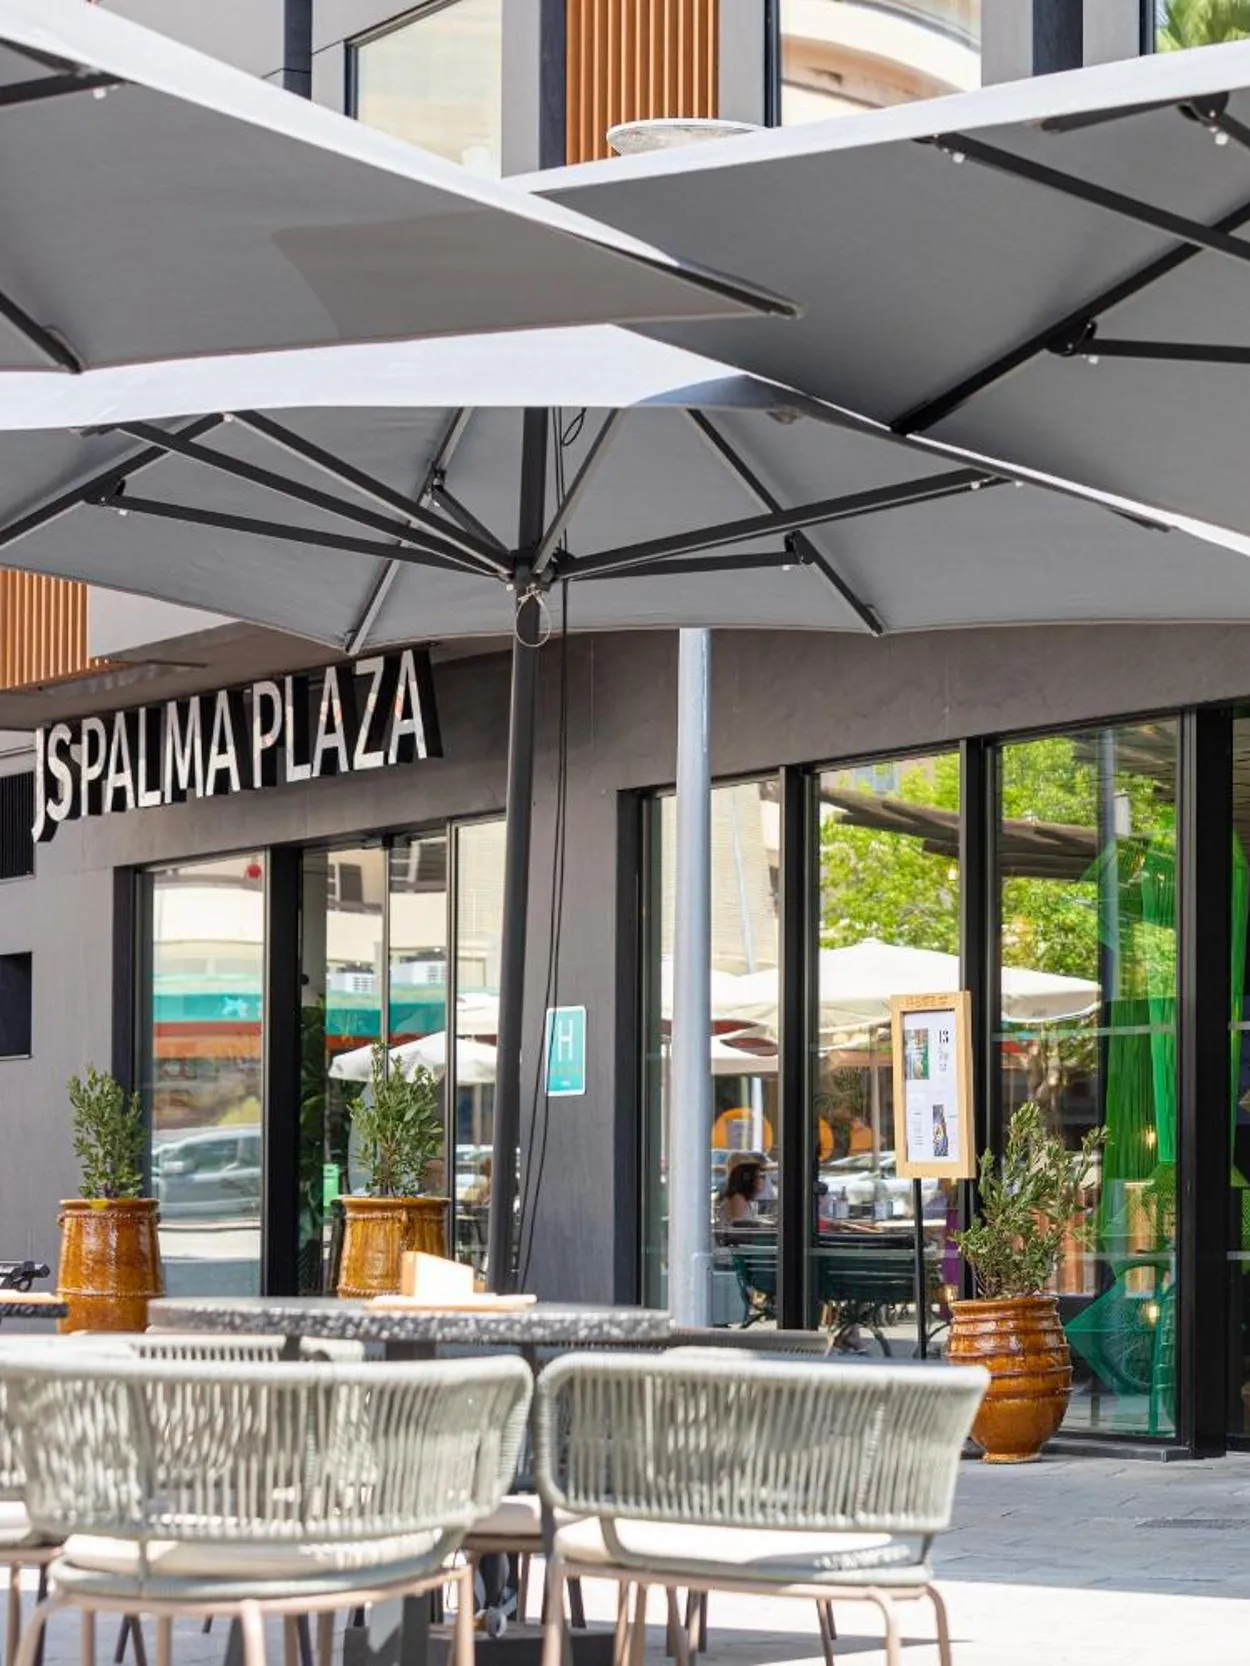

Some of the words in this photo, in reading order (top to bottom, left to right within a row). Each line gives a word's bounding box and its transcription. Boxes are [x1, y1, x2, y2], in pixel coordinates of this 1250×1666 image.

[31, 724, 73, 842] JS
[80, 689, 241, 817] PALMA
[253, 649, 428, 788] PLAZA
[558, 1019, 573, 1062] H
